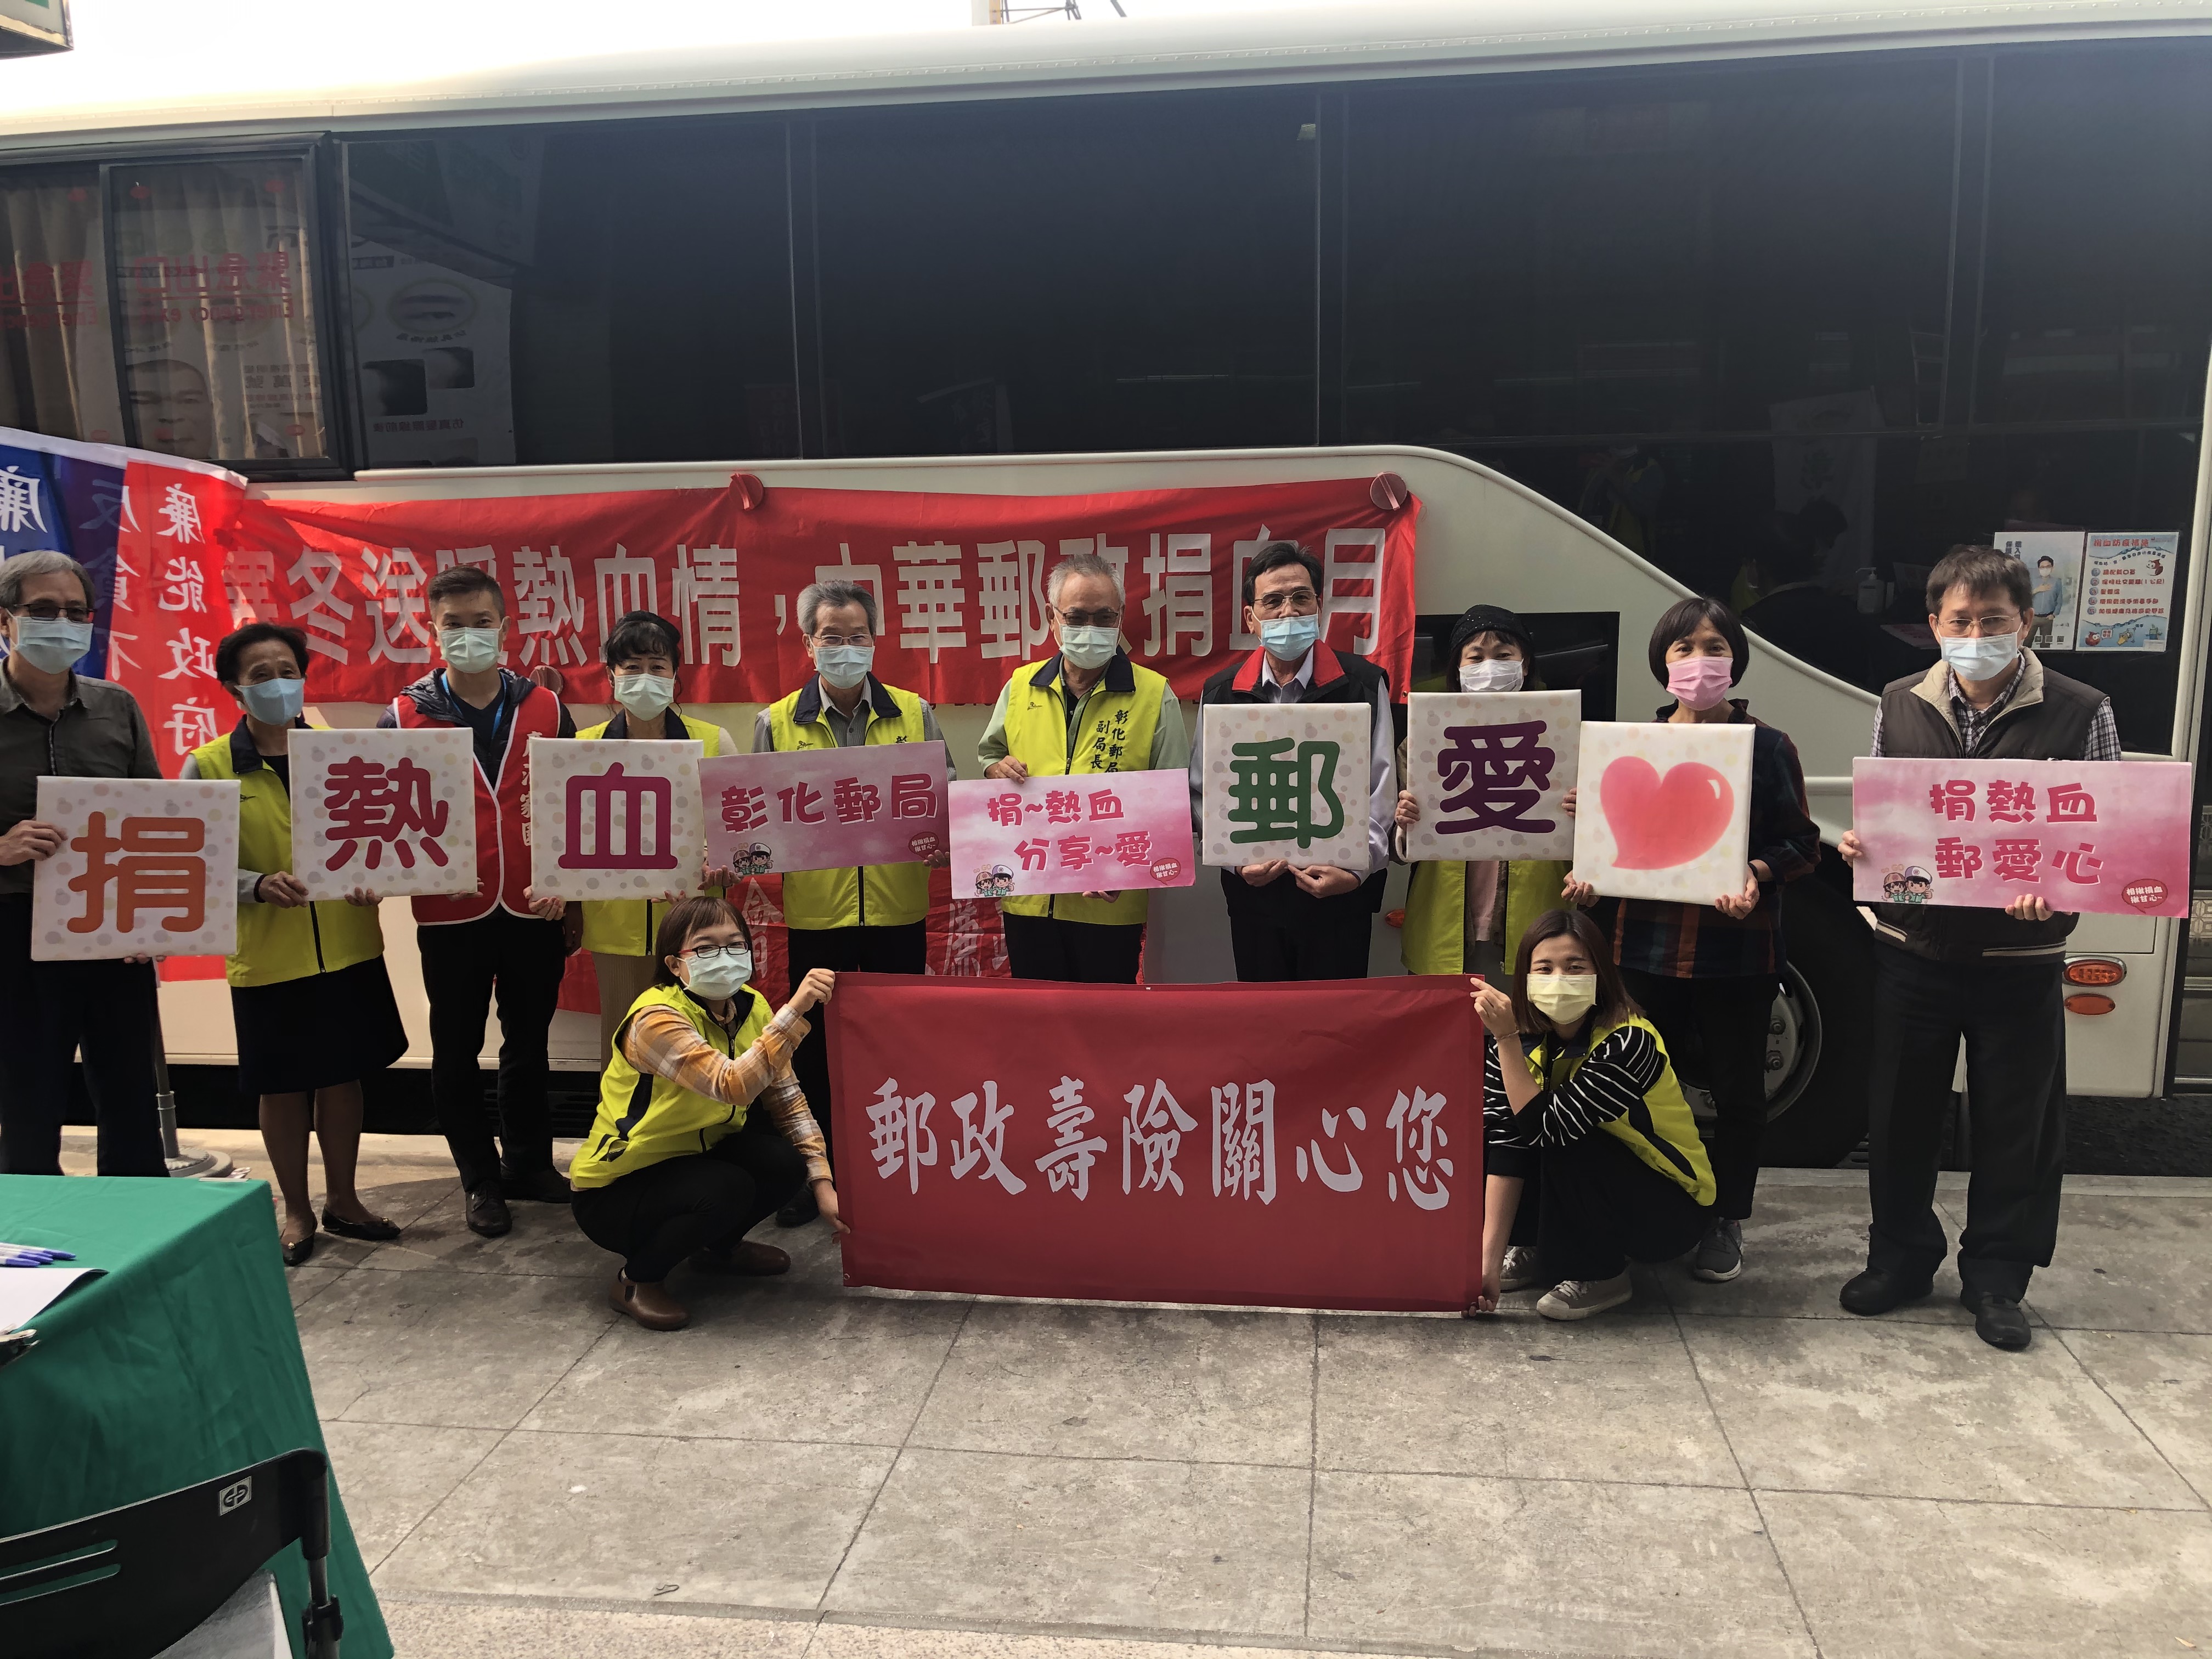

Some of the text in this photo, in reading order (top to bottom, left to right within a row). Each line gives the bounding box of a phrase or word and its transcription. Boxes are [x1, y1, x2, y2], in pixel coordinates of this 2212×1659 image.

[1091, 720, 1110, 769] 副局長
[1227, 737, 1344, 849] 郵
[1435, 720, 1556, 834] 愛
[324, 755, 449, 871] 熱
[558, 762, 678, 870] 血
[720, 773, 938, 833] 彰化郵局
[1929, 779, 2098, 824] 捐熱血
[66, 811, 206, 933] 捐
[1935, 837, 2103, 885] 郵愛心
[865, 1075, 1454, 1210] 郵政壽險關心您
